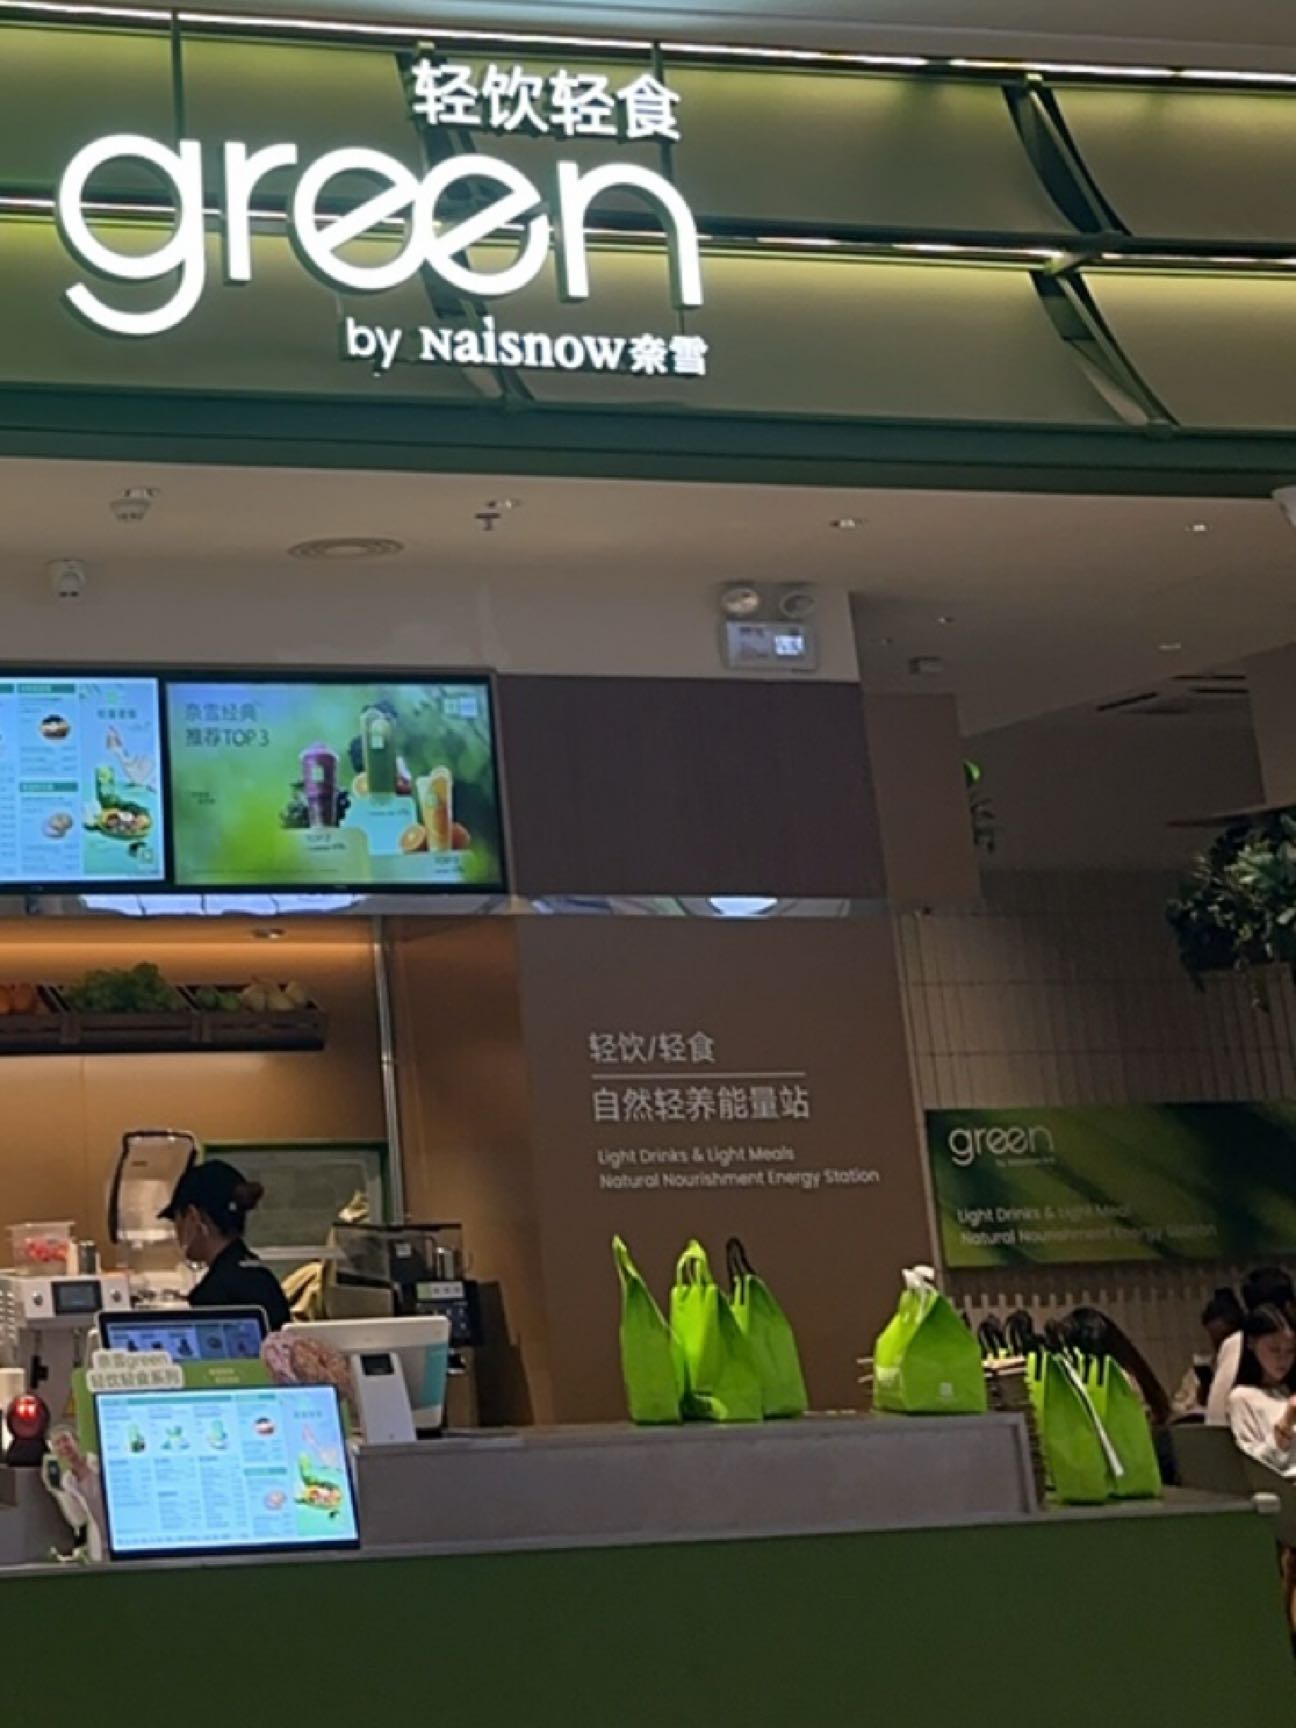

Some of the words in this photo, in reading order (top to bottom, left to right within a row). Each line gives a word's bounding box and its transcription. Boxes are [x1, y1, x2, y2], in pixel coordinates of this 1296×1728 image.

[412, 59, 681, 139] 轻饮轻食
[59, 134, 703, 334] green
[345, 316, 402, 369] by
[589, 1031, 716, 1064] 轻饮/轻食
[592, 1085, 810, 1122] 自然轻养能量站
[597, 1148, 637, 1169] Light
[640, 1147, 689, 1165] Drinks
[691, 1146, 705, 1163] &
[707, 1145, 745, 1168] Light
[748, 1144, 795, 1163] Meals
[948, 1124, 1054, 1166] green
[599, 1170, 660, 1190] Natural
[662, 1169, 765, 1188] Nourishment
[767, 1168, 821, 1190] Energy
[823, 1166, 881, 1184] Station
